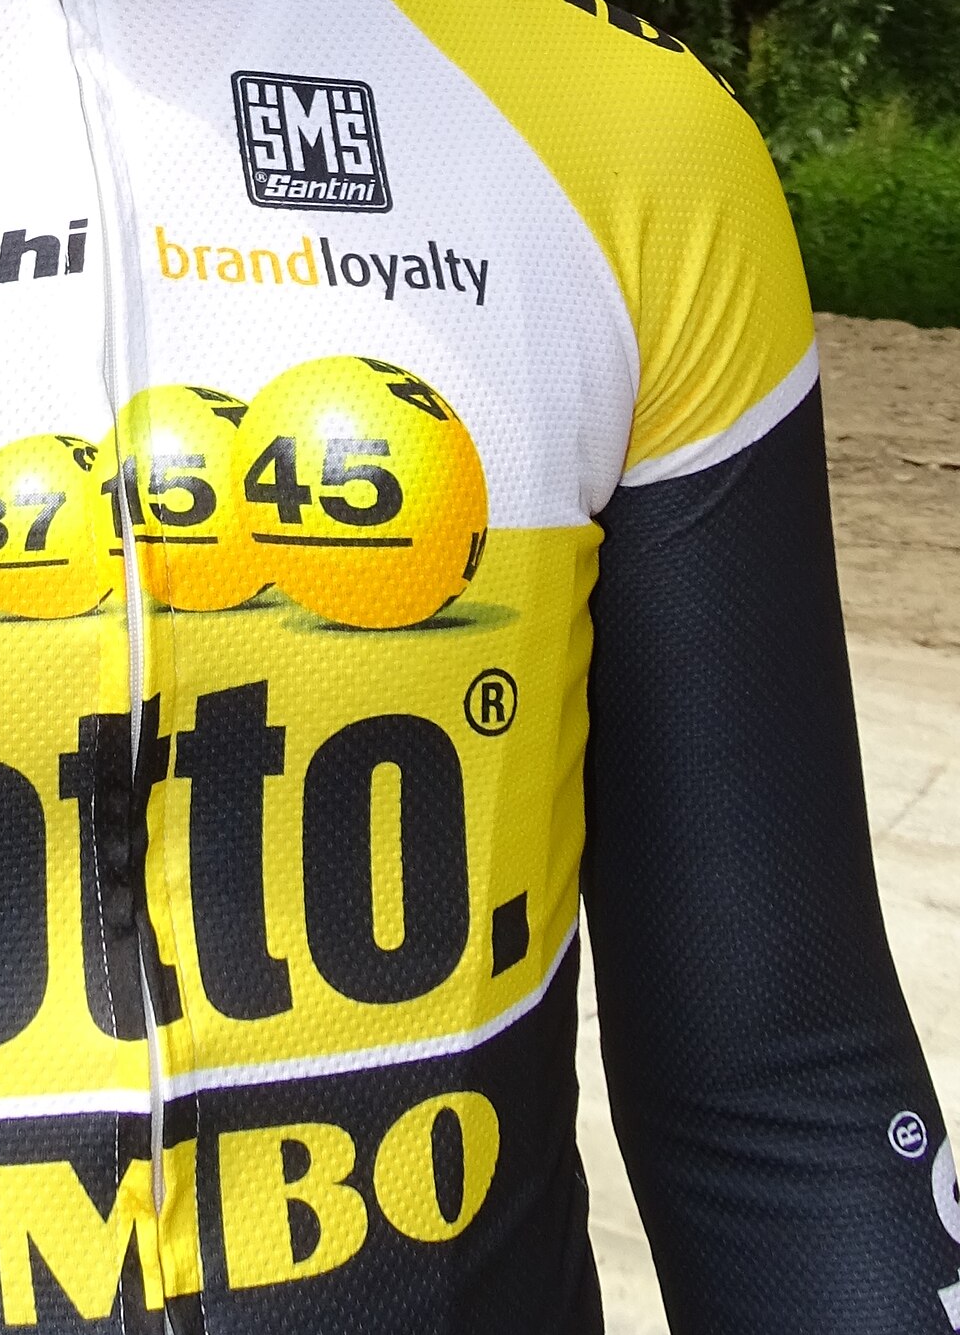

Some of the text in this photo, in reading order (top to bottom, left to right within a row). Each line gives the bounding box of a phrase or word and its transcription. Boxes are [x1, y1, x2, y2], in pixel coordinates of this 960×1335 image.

[263, 173, 377, 202] Santini
[155, 226, 489, 306] brandloyalty
[100, 453, 218, 539] 15
[243, 434, 404, 527] 45
